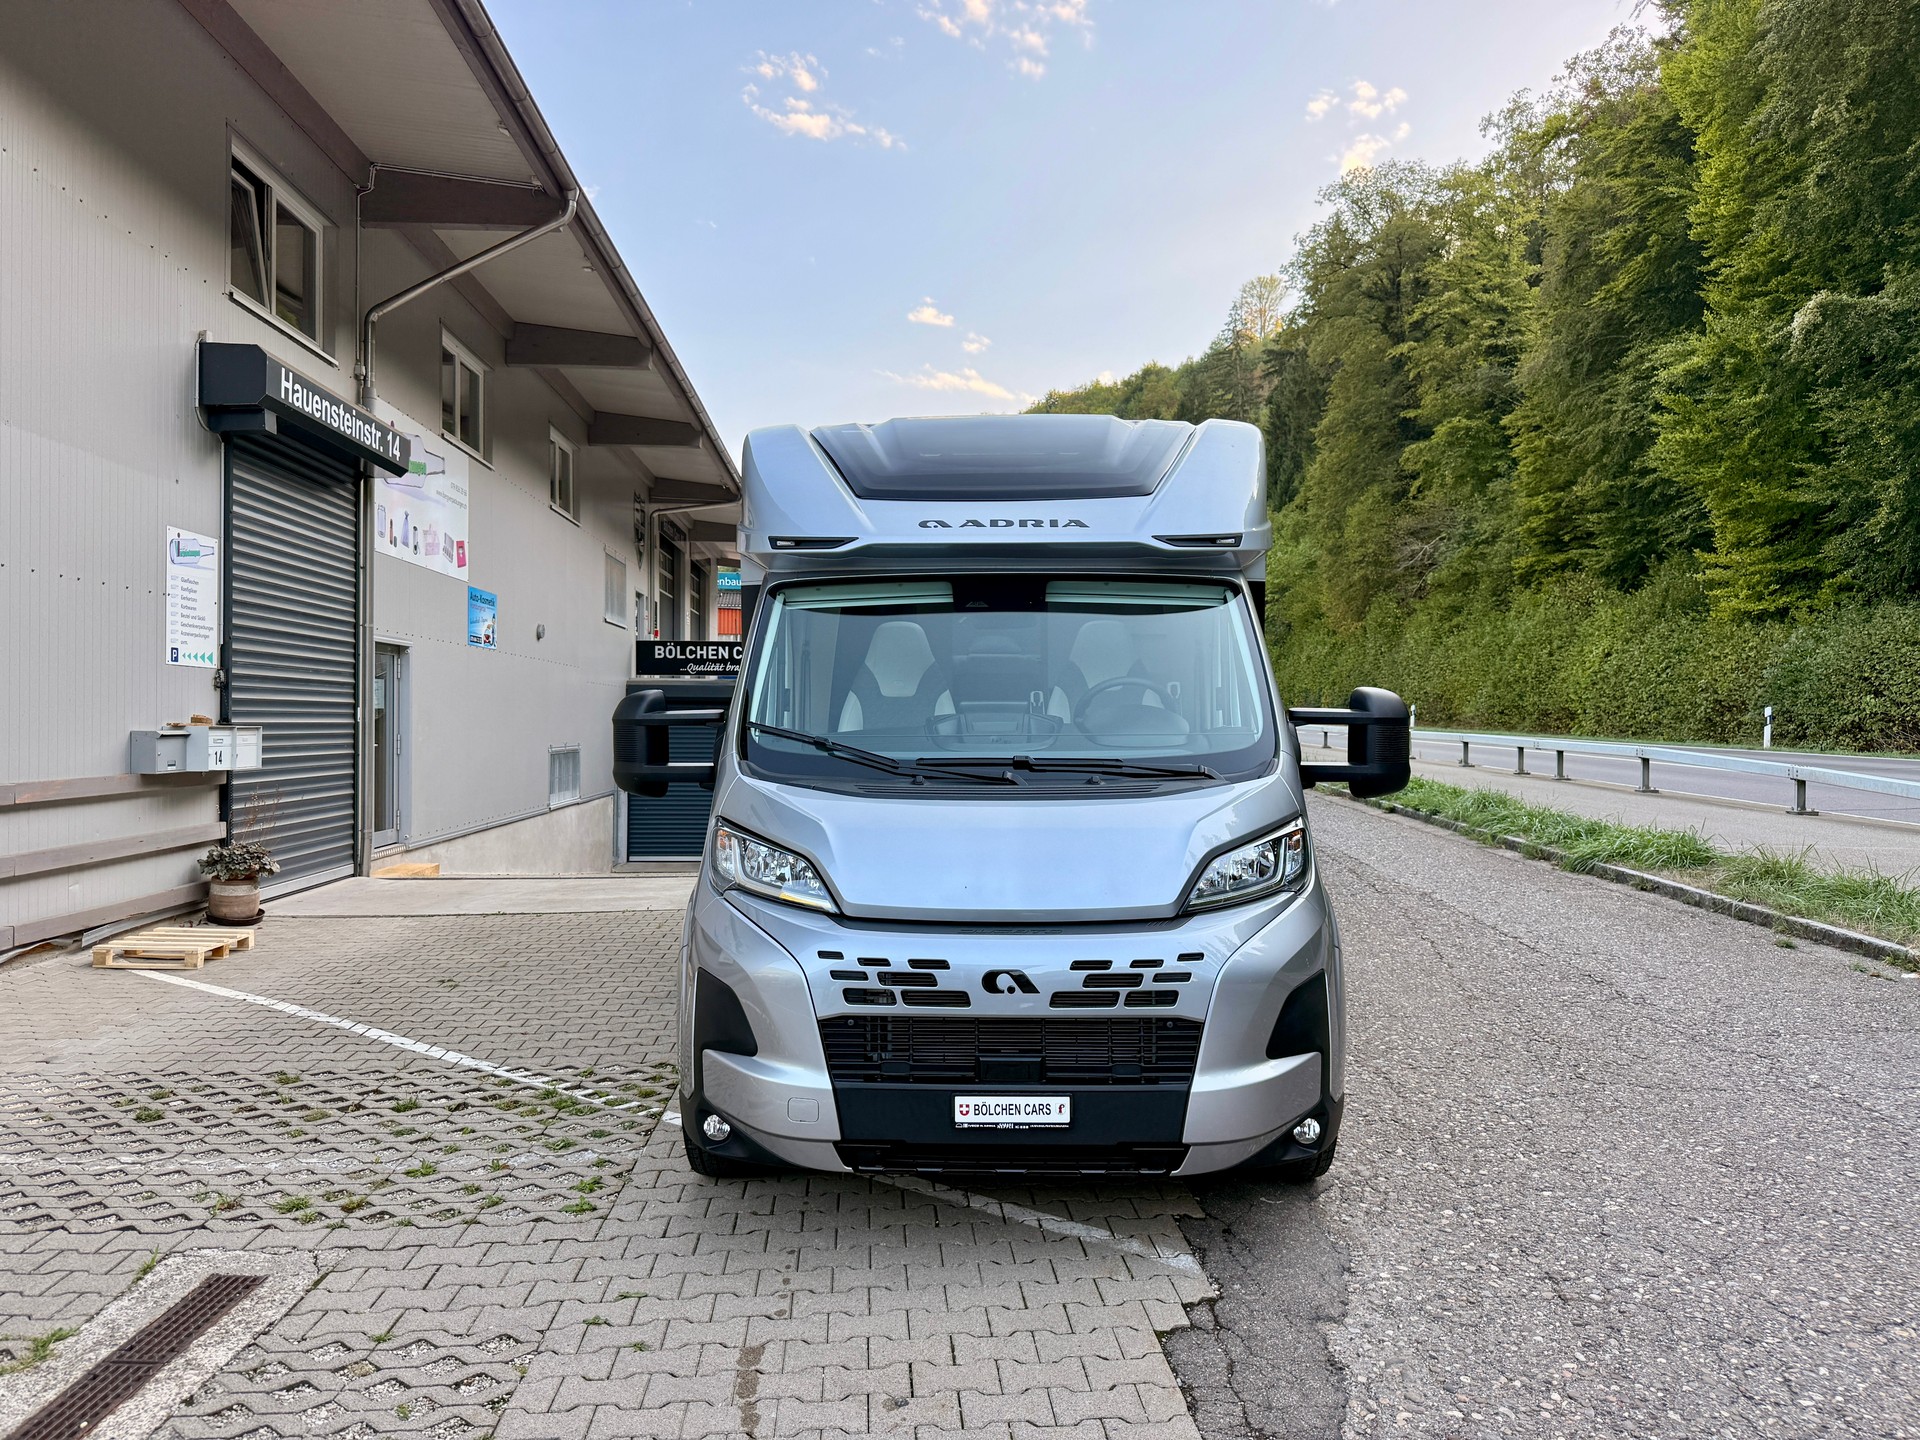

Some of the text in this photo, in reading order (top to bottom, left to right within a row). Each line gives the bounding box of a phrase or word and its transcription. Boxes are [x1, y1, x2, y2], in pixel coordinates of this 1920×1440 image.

[280, 367, 400, 461] Hauensteinstr. 14
[959, 519, 1090, 528] ADRIA
[654, 642, 729, 659] BÖLCHEN
[214, 750, 223, 766] 14
[973, 1101, 1052, 1116] BÖLCHEN CARS
